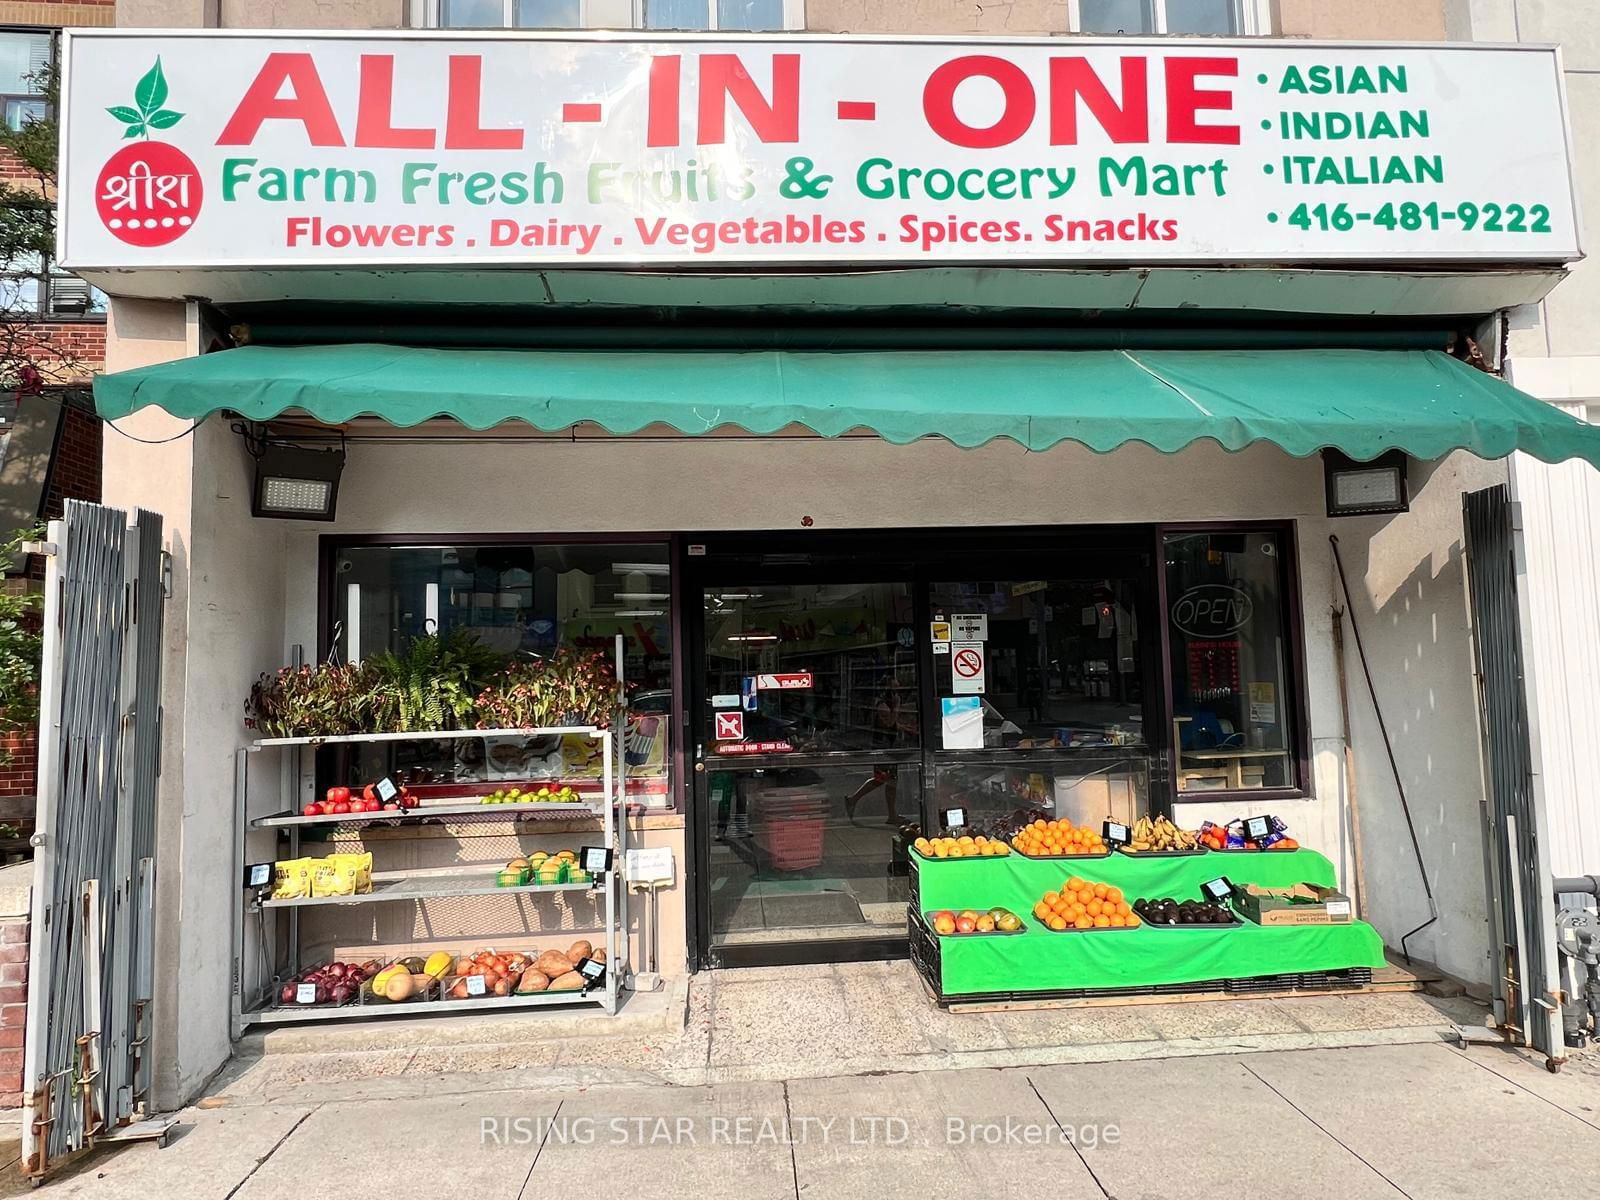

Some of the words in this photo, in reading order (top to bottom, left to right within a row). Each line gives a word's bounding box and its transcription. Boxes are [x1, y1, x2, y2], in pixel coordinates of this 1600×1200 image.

[1279, 64, 1408, 94] ASIAN
[216, 53, 524, 149] ALL
[648, 54, 800, 147] IN
[923, 55, 1240, 148] ONE
[1280, 109, 1430, 140] INDIAN
[222, 157, 376, 203] Farm
[403, 162, 562, 206] Fresh
[588, 159, 755, 205] Fruits
[779, 156, 833, 200] &
[856, 157, 1076, 201] Grocery
[1098, 155, 1228, 198] Mart
[1282, 154, 1445, 185] ITALIAN
[287, 217, 453, 247] Flowers
[491, 219, 600, 254] Dairy
[636, 215, 865, 253] Vegetables
[1045, 213, 1177, 241] Snacks
[1288, 201, 1552, 234] 416-481-9222
[1176, 599, 1244, 625] OPEN
